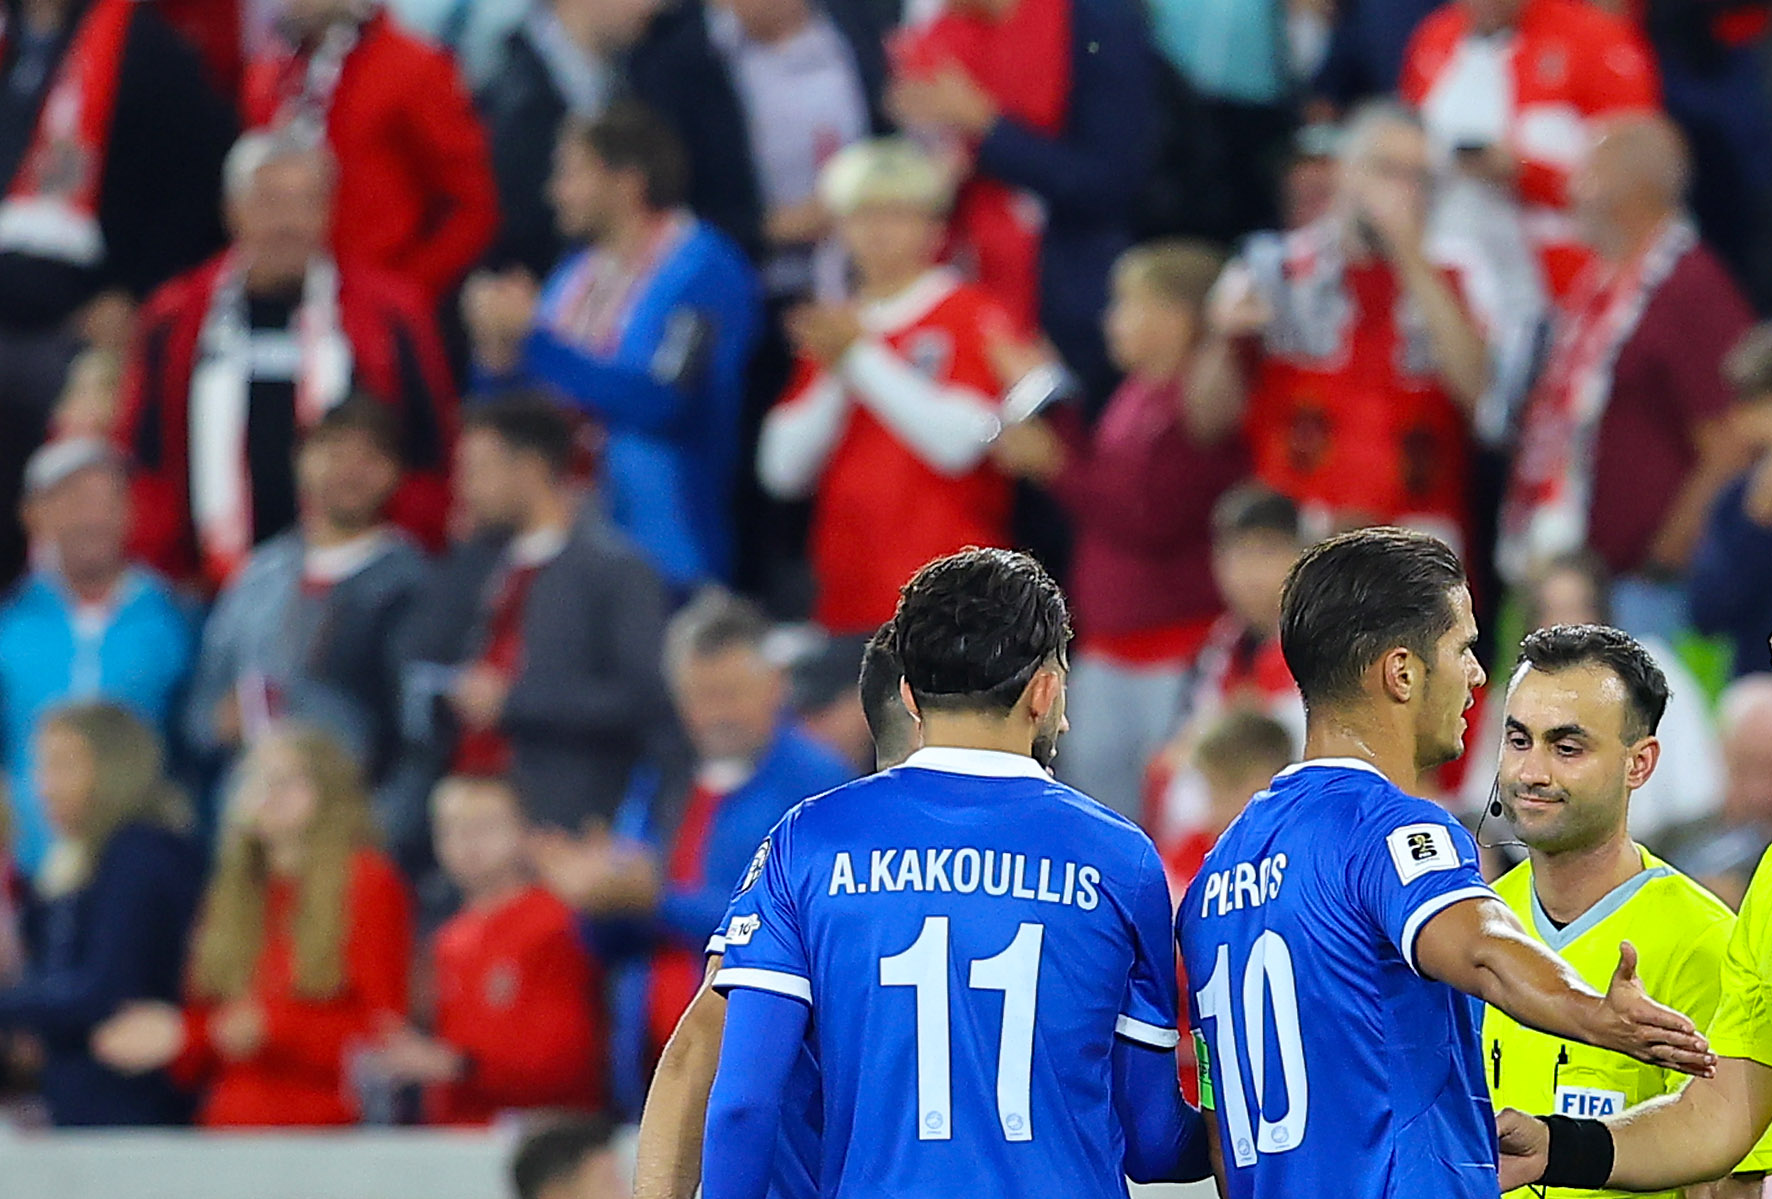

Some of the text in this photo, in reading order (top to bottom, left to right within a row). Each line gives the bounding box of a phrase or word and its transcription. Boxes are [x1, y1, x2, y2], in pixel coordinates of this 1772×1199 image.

[828, 846, 1101, 911] A.KAKOULLIS
[879, 916, 1044, 1141] 11
[1196, 929, 1308, 1168] 10
[1562, 1093, 1614, 1117] FIFA
